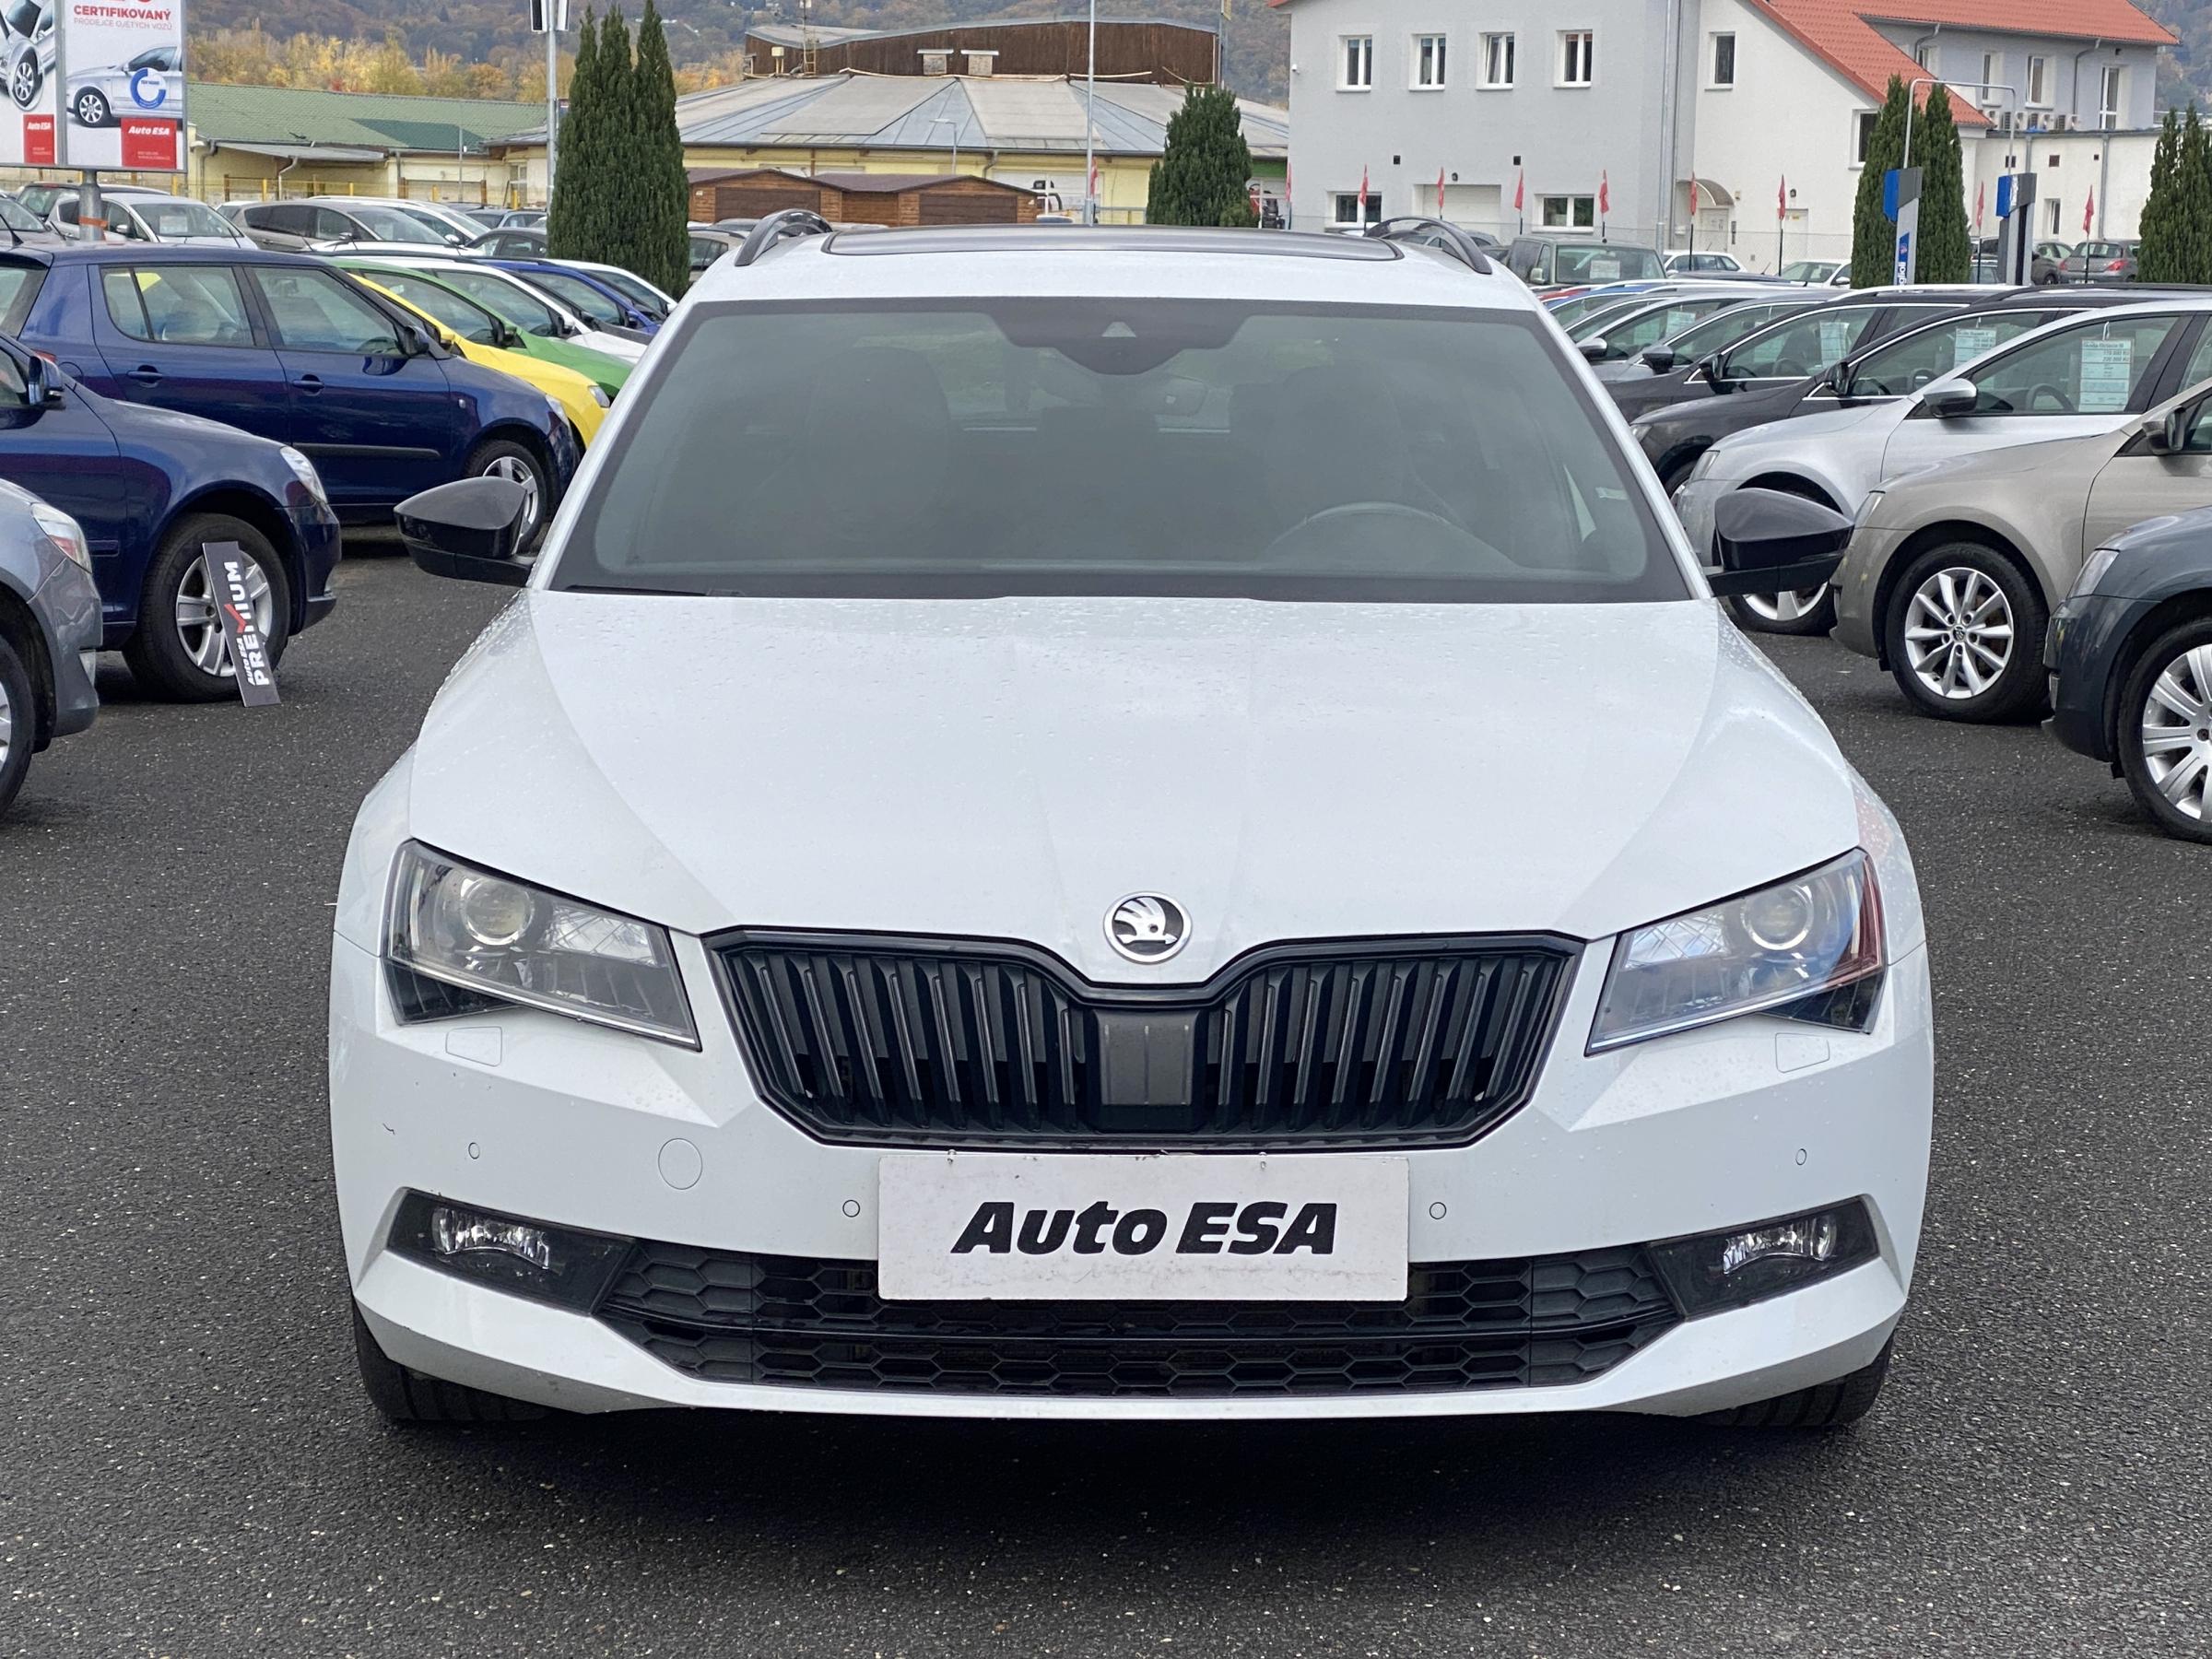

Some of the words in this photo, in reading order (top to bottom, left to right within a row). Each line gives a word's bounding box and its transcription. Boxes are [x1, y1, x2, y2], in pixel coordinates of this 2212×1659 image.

[74, 6, 171, 20] CERTIFIKOVANÝ
[128, 125, 151, 135] Auto
[152, 127, 170, 135] ESA
[224, 561, 270, 687] PREMIUM
[243, 658, 255, 686] Auto
[949, 1200, 1168, 1255] Auto
[1175, 1200, 1337, 1255] ESA
